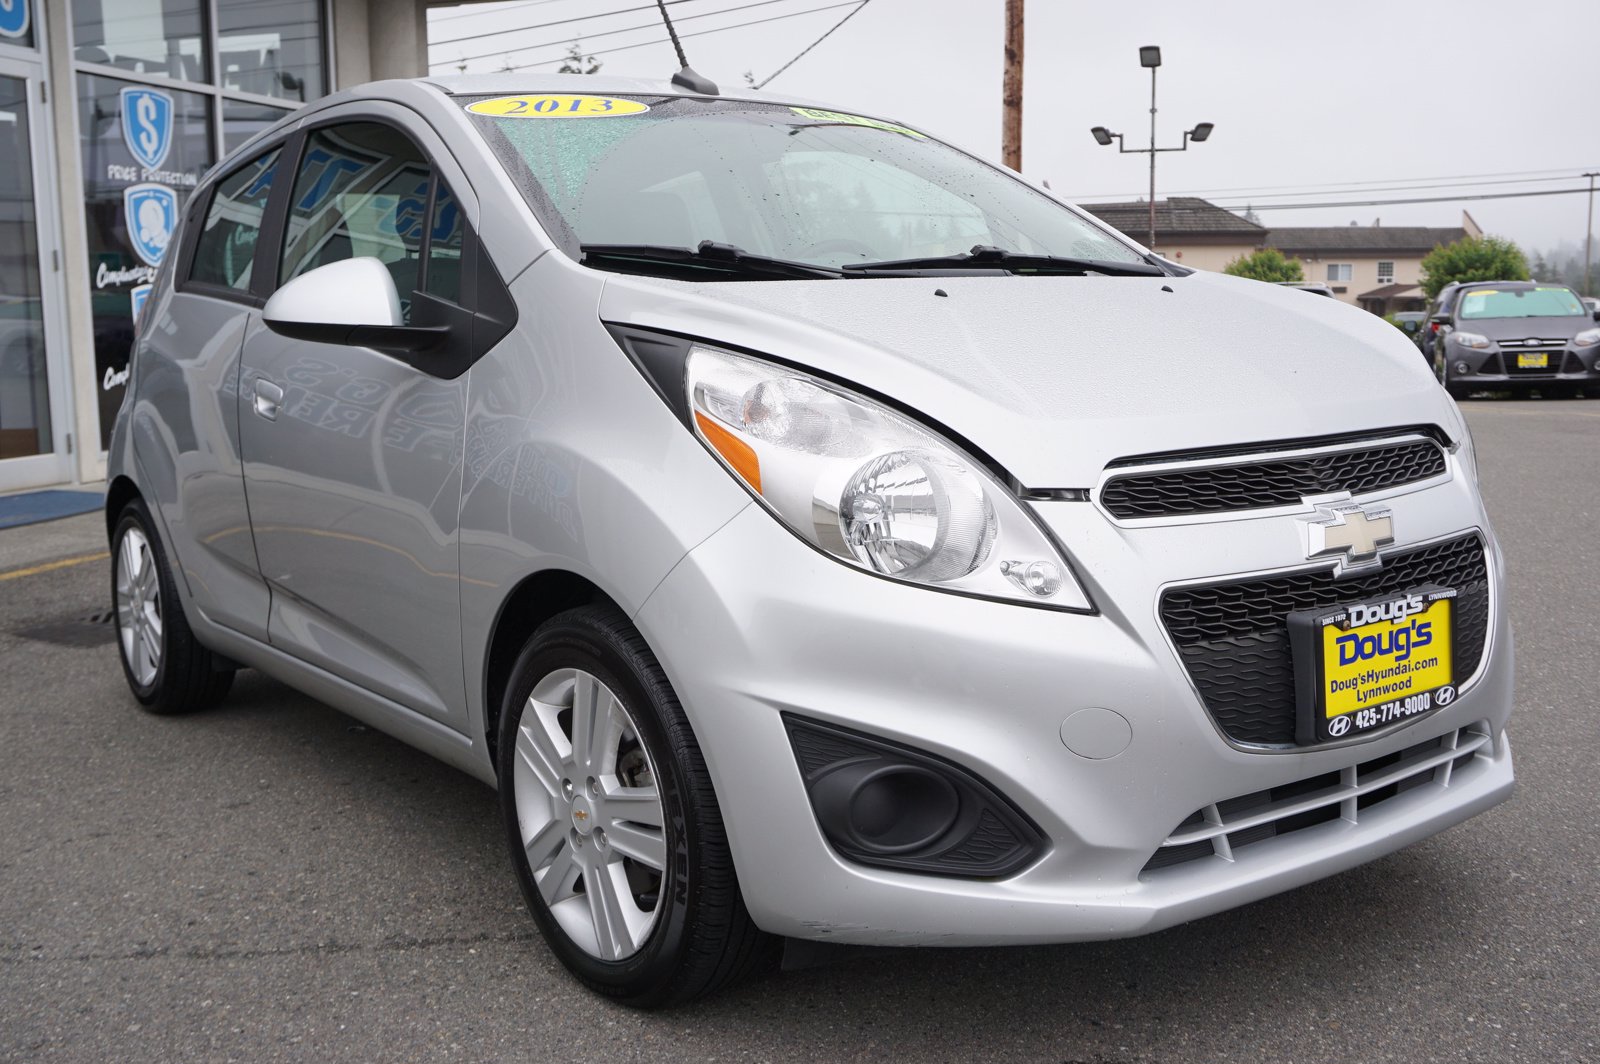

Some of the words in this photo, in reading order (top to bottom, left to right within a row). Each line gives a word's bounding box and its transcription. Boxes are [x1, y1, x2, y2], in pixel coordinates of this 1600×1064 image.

[502, 98, 613, 115] 2013
[107, 164, 137, 182] PRICE
[141, 168, 197, 186] PROTECTION
[1428, 590, 1457, 601] LYNNWOOD
[1322, 616, 1334, 626] SINCE
[1348, 595, 1423, 628] Doug's
[1336, 619, 1432, 667] Doug's
[1330, 655, 1438, 694] Doug'sHyundai.com
[1356, 676, 1412, 703] Lynnwood
[1355, 692, 1431, 730] 425-774-9000
